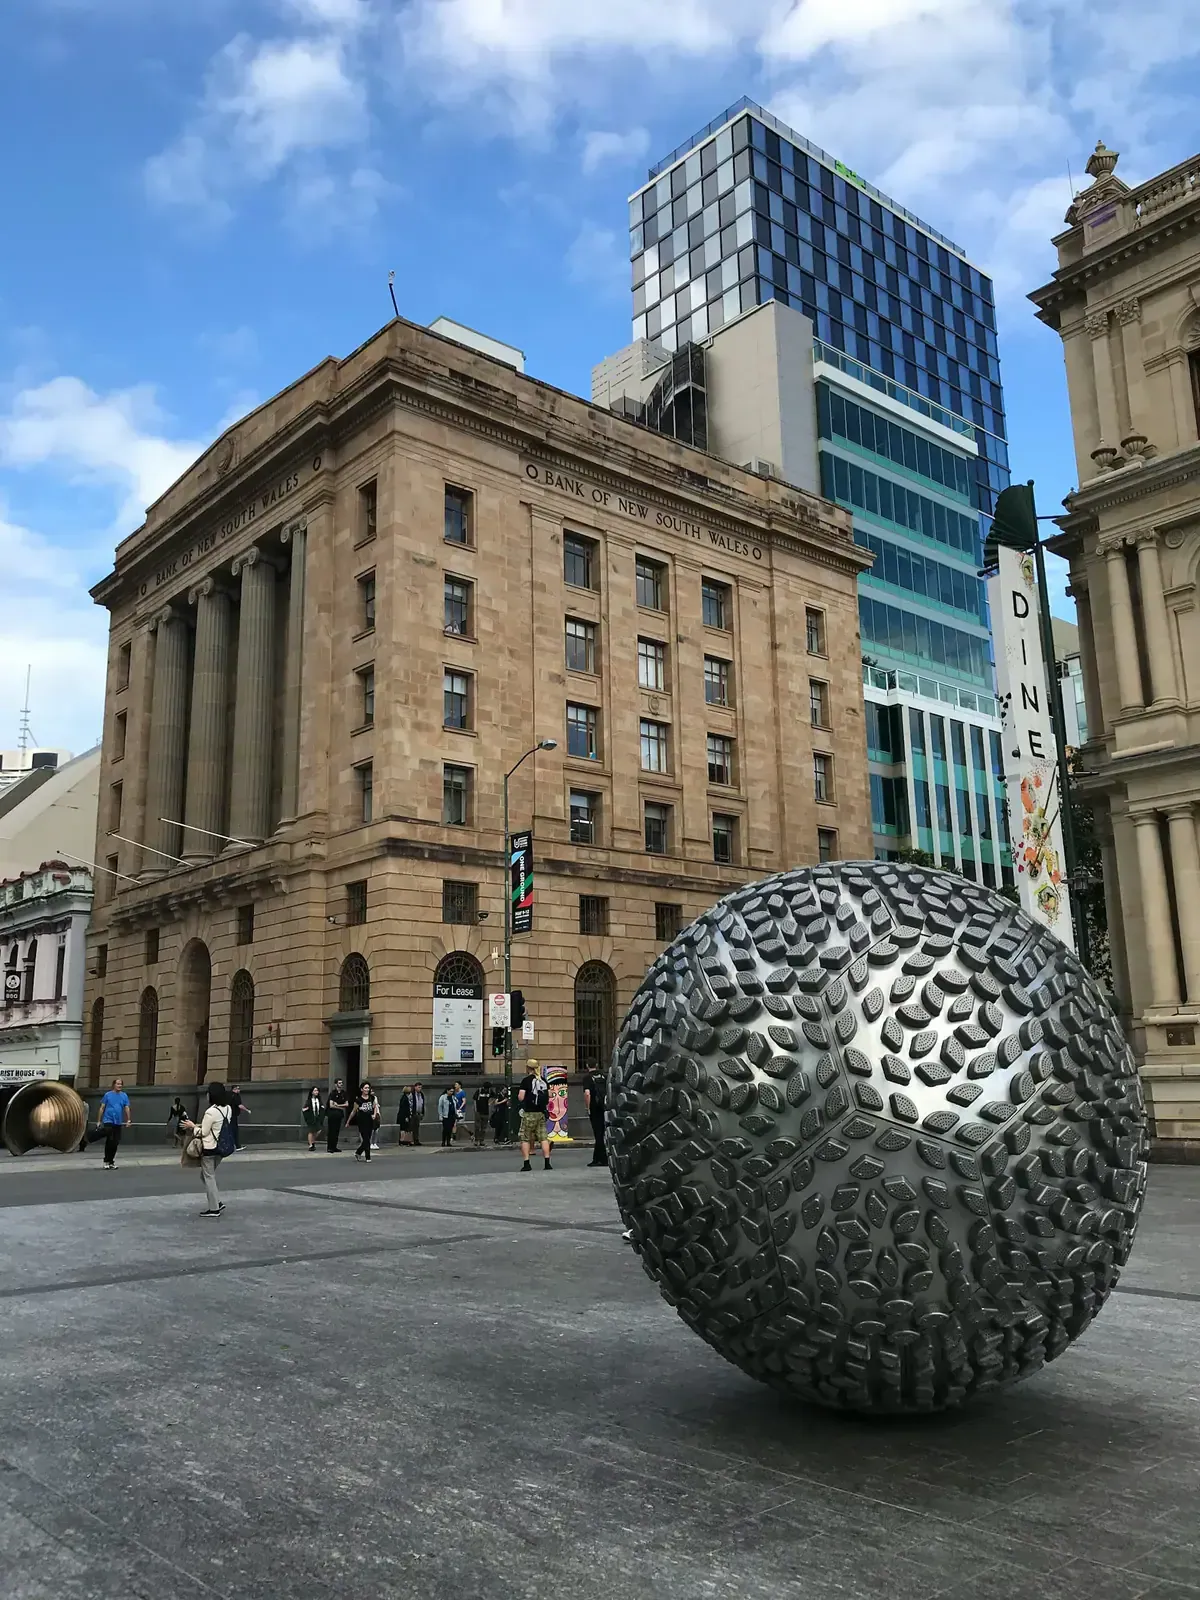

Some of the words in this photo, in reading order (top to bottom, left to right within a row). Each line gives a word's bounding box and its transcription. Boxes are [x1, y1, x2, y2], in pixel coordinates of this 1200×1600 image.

[156, 562, 178, 586] BANK
[182, 549, 194, 566] OF
[197, 532, 217, 557] NEW
[220, 502, 256, 539] SOUTH
[261, 473, 299, 509] WALES
[545, 470, 585, 498] BANK
[592, 489, 611, 506] OF
[618, 498, 649, 519] NEW
[655, 512, 701, 540] SOUTH
[708, 531, 749, 557] WALES
[1012, 590, 1046, 759] DINE
[436, 985, 449, 995] For
[451, 985, 474, 996] Lease
[15, 1069, 35, 1077] HOUSE
